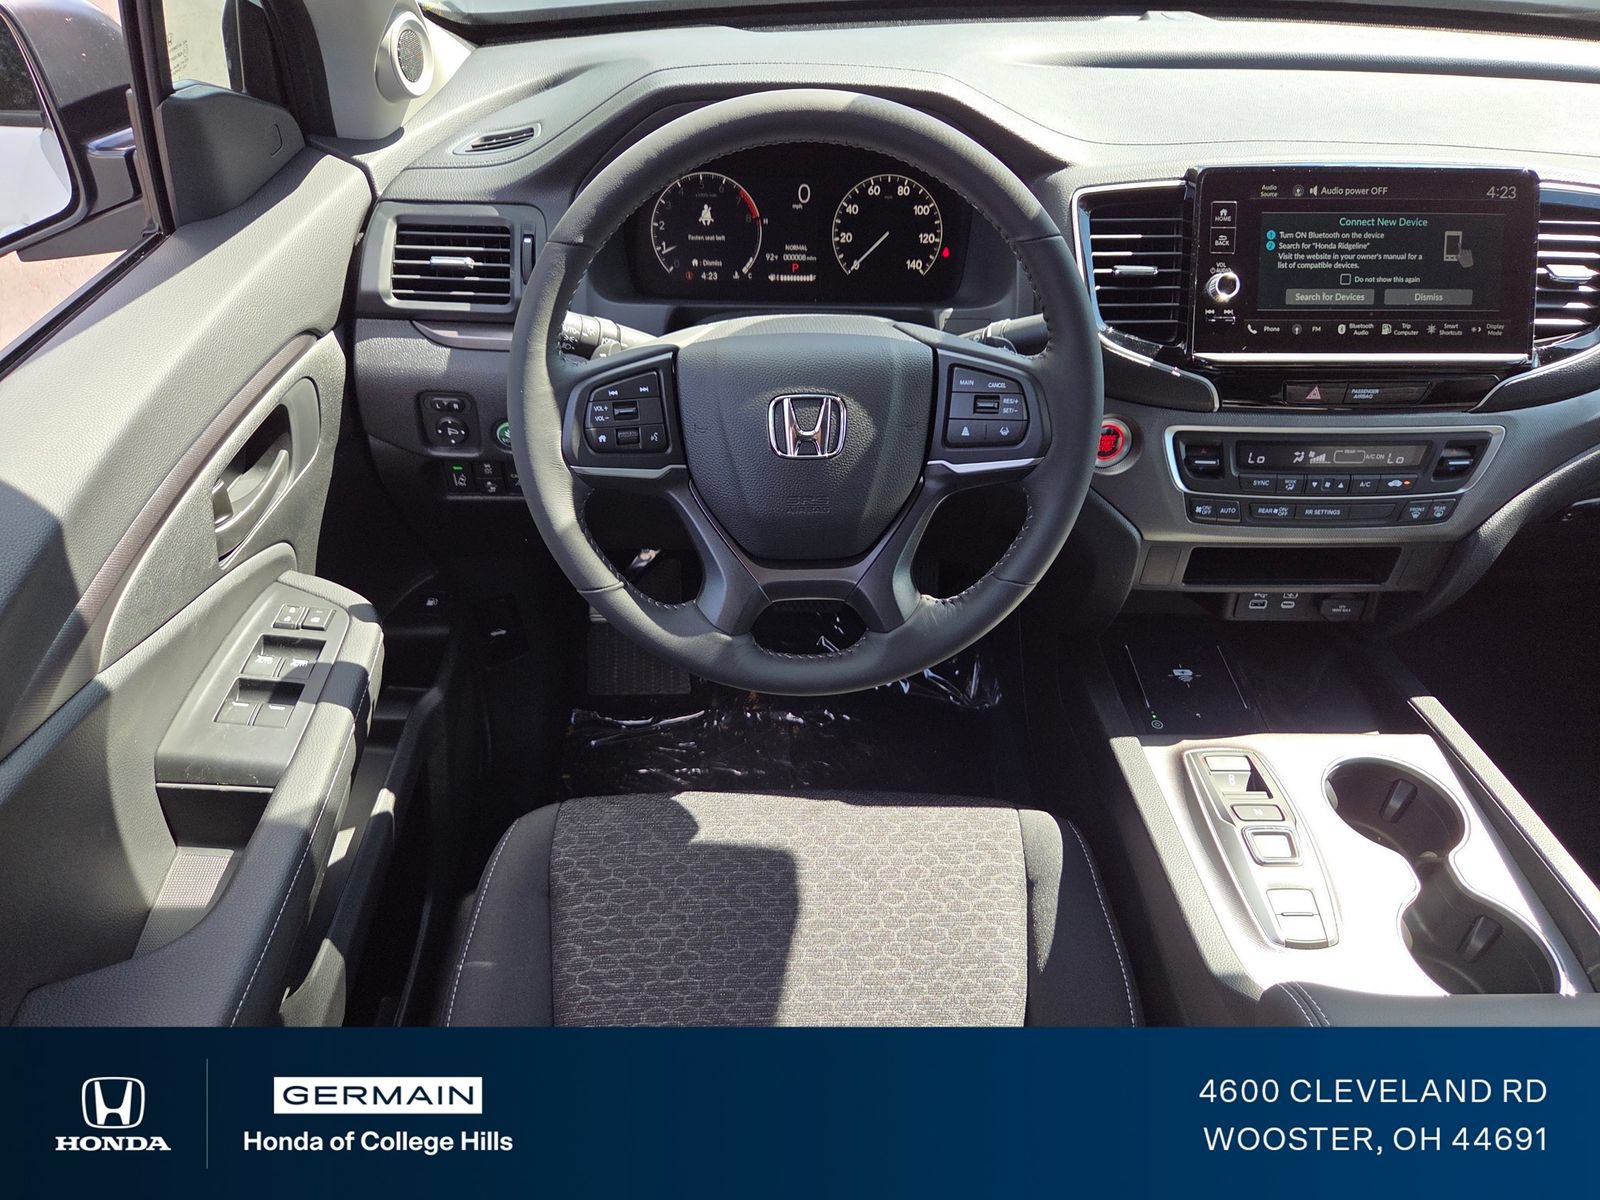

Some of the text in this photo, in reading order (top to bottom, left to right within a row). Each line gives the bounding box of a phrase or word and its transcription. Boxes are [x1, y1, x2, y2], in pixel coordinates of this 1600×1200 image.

[798, 183, 811, 204] 0
[867, 185, 881, 196] 60
[897, 185, 910, 196] 80
[1320, 186, 1389, 197] Audio power OFF
[1486, 185, 1517, 199] 4:23
[845, 204, 859, 215] 40
[913, 204, 930, 215] 100
[659, 221, 665, 231] 2
[1339, 217, 1428, 227] Connect New Device
[840, 232, 853, 243] 20
[918, 233, 935, 244] 120
[1279, 231, 1294, 239] Turn
[1295, 231, 1307, 239] ON
[1308, 231, 1341, 239] Bluetooth
[1351, 231, 1362, 239] the
[1363, 231, 1385, 239] device
[785, 244, 807, 252] NORMAL
[1278, 242, 1300, 250] Search
[1301, 242, 1311, 250] for
[1337, 242, 1370, 251] Ridgeline"
[1278, 252, 1293, 260] Visit
[1294, 252, 1305, 260] the
[1305, 252, 1332, 260] website
[1332, 252, 1340, 260] in
[1340, 253, 1356, 261] your
[1382, 252, 1407, 260] manual
[1407, 252, 1417, 260] for
[792, 263, 799, 272] P
[906, 259, 923, 270] 140
[1277, 261, 1288, 269] list
[1296, 261, 1333, 270] compatible
[1333, 261, 1360, 269] devices.
[701, 271, 718, 280] 4:23
[1404, 276, 1421, 284] again
[1295, 292, 1365, 301] Search for Devices
[1414, 293, 1444, 301] Dismiss
[1247, 451, 1266, 464] Lo
[1386, 452, 1405, 464] Lo
